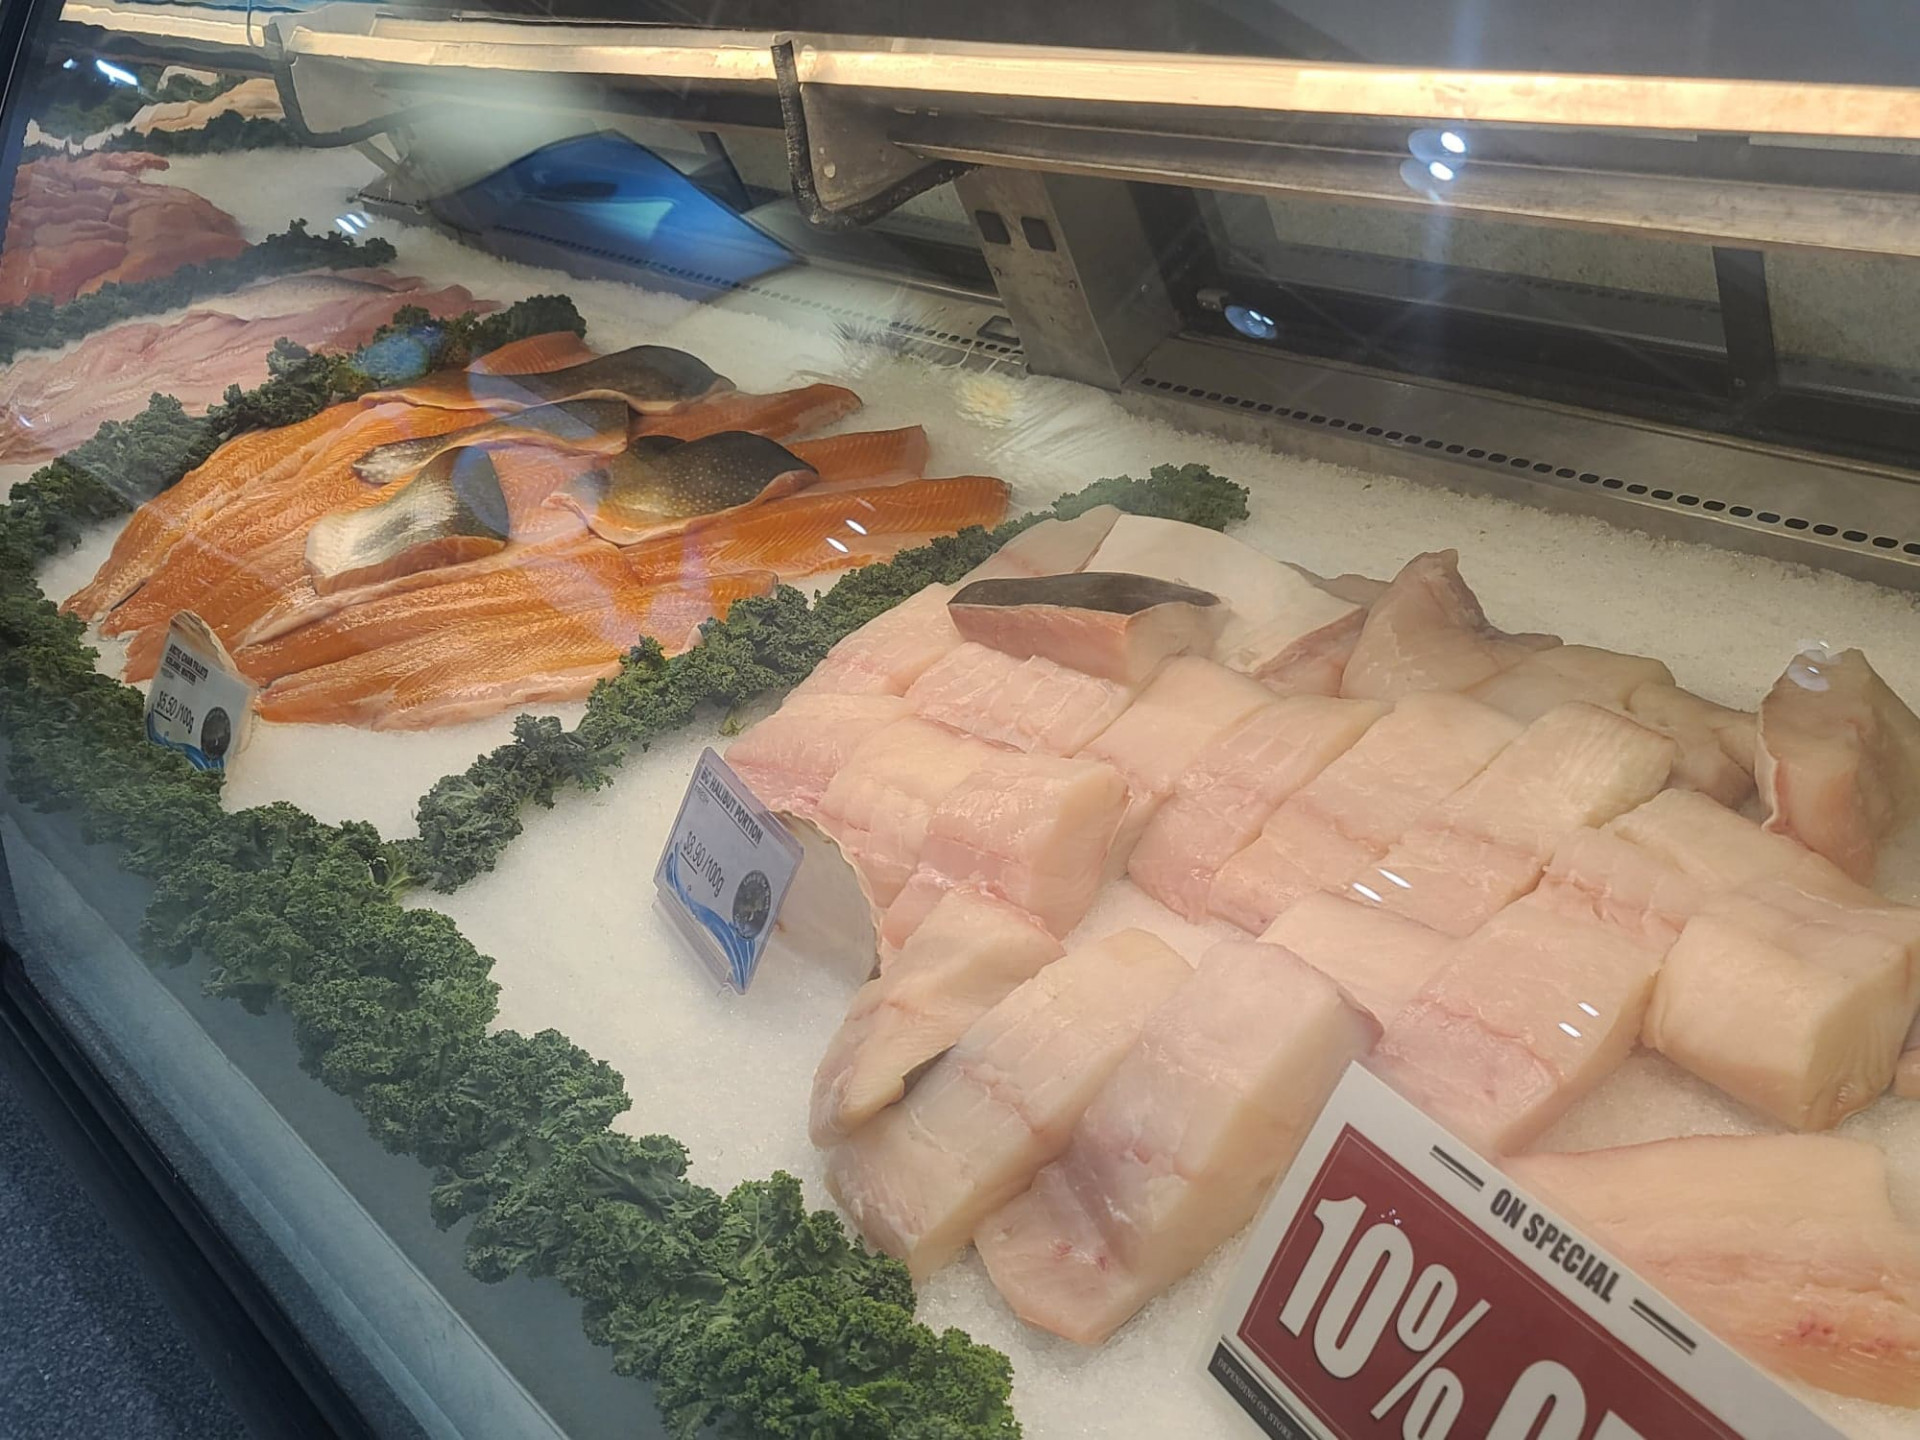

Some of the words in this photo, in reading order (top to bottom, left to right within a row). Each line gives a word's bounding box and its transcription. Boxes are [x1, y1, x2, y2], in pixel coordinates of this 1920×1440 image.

[708, 776, 737, 813] HALIBUT
[733, 804, 764, 845] PORTION
[701, 854, 725, 898] /100g
[1490, 1188, 1524, 1229] ON
[1522, 1212, 1621, 1303] SPECIAL
[1278, 1195, 1492, 1440] 10%
[1217, 1357, 1258, 1403] DEPENDING
[1256, 1399, 1270, 1416] ON
[1267, 1412, 1295, 1440] STORE
